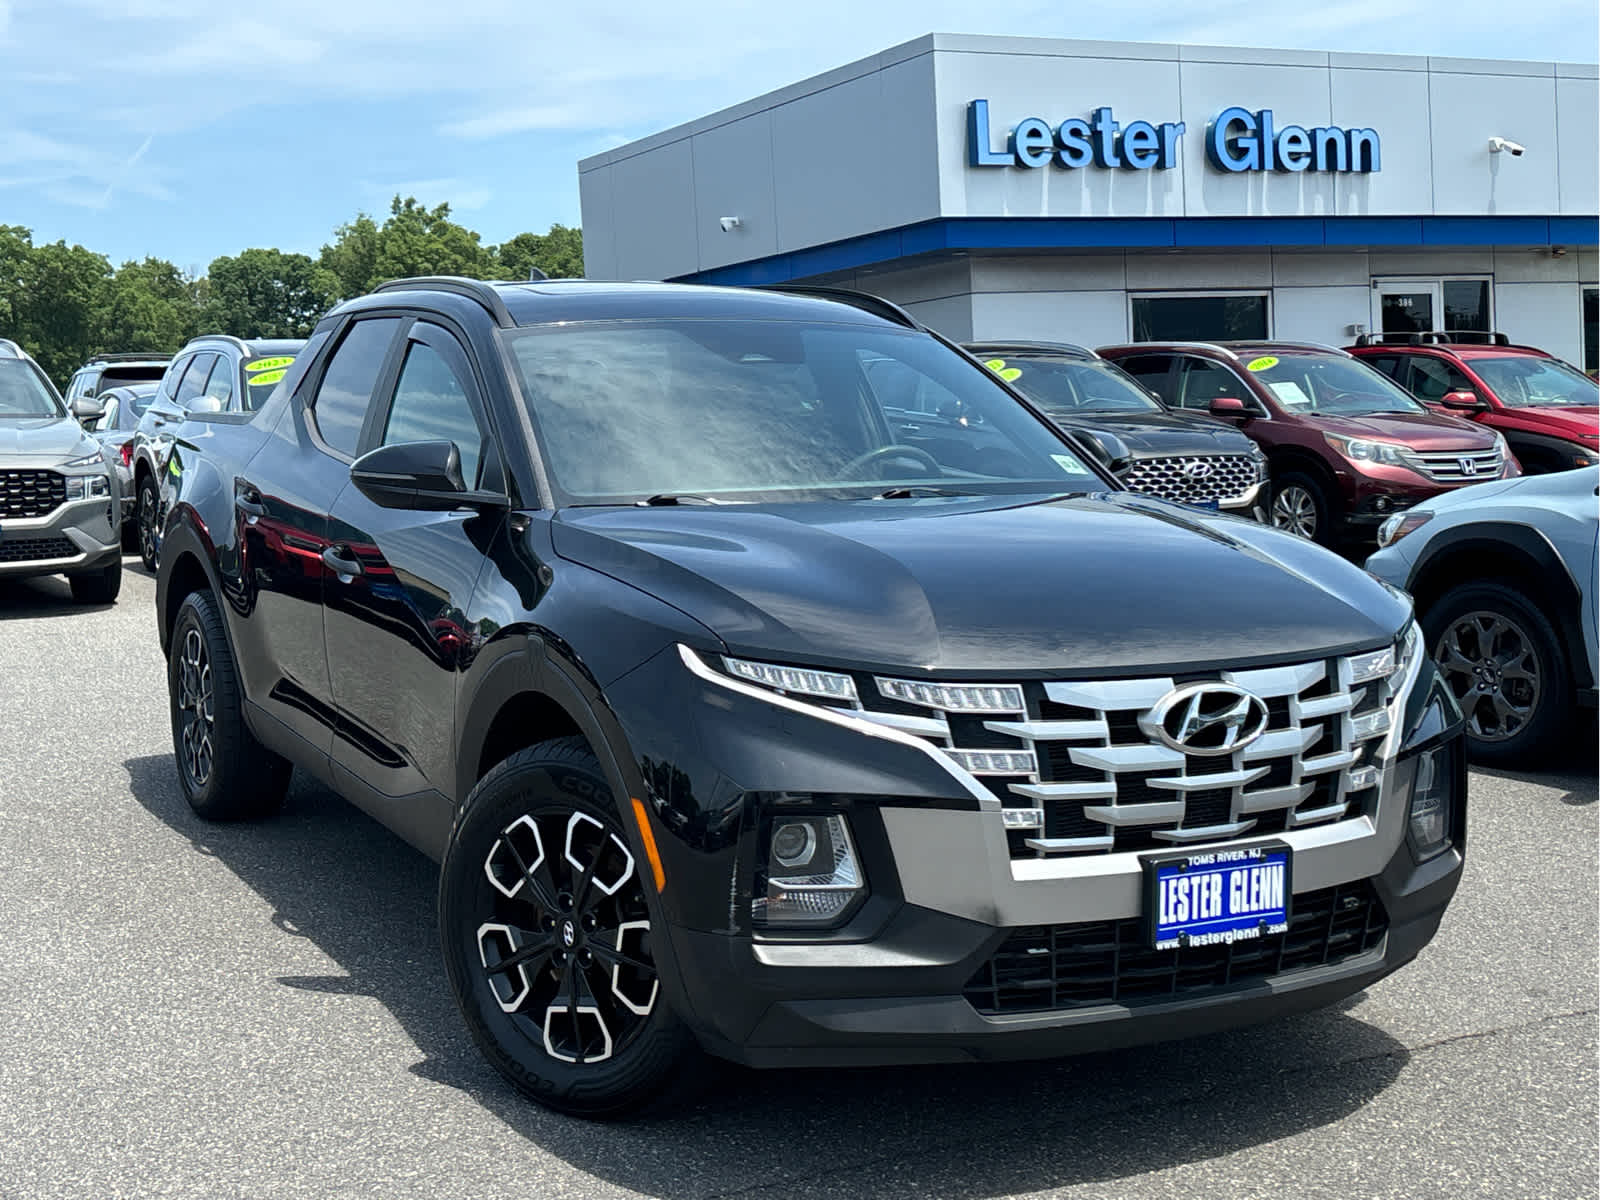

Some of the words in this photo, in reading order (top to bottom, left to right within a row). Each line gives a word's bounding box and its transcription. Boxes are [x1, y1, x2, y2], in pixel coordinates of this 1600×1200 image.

[967, 98, 1186, 170] Lester
[1206, 106, 1382, 174] Glenn
[1188, 854, 1215, 867] TOMS
[1249, 848, 1262, 858] NJ
[1159, 873, 1222, 925] LESTER
[1229, 864, 1284, 914] GLENN
